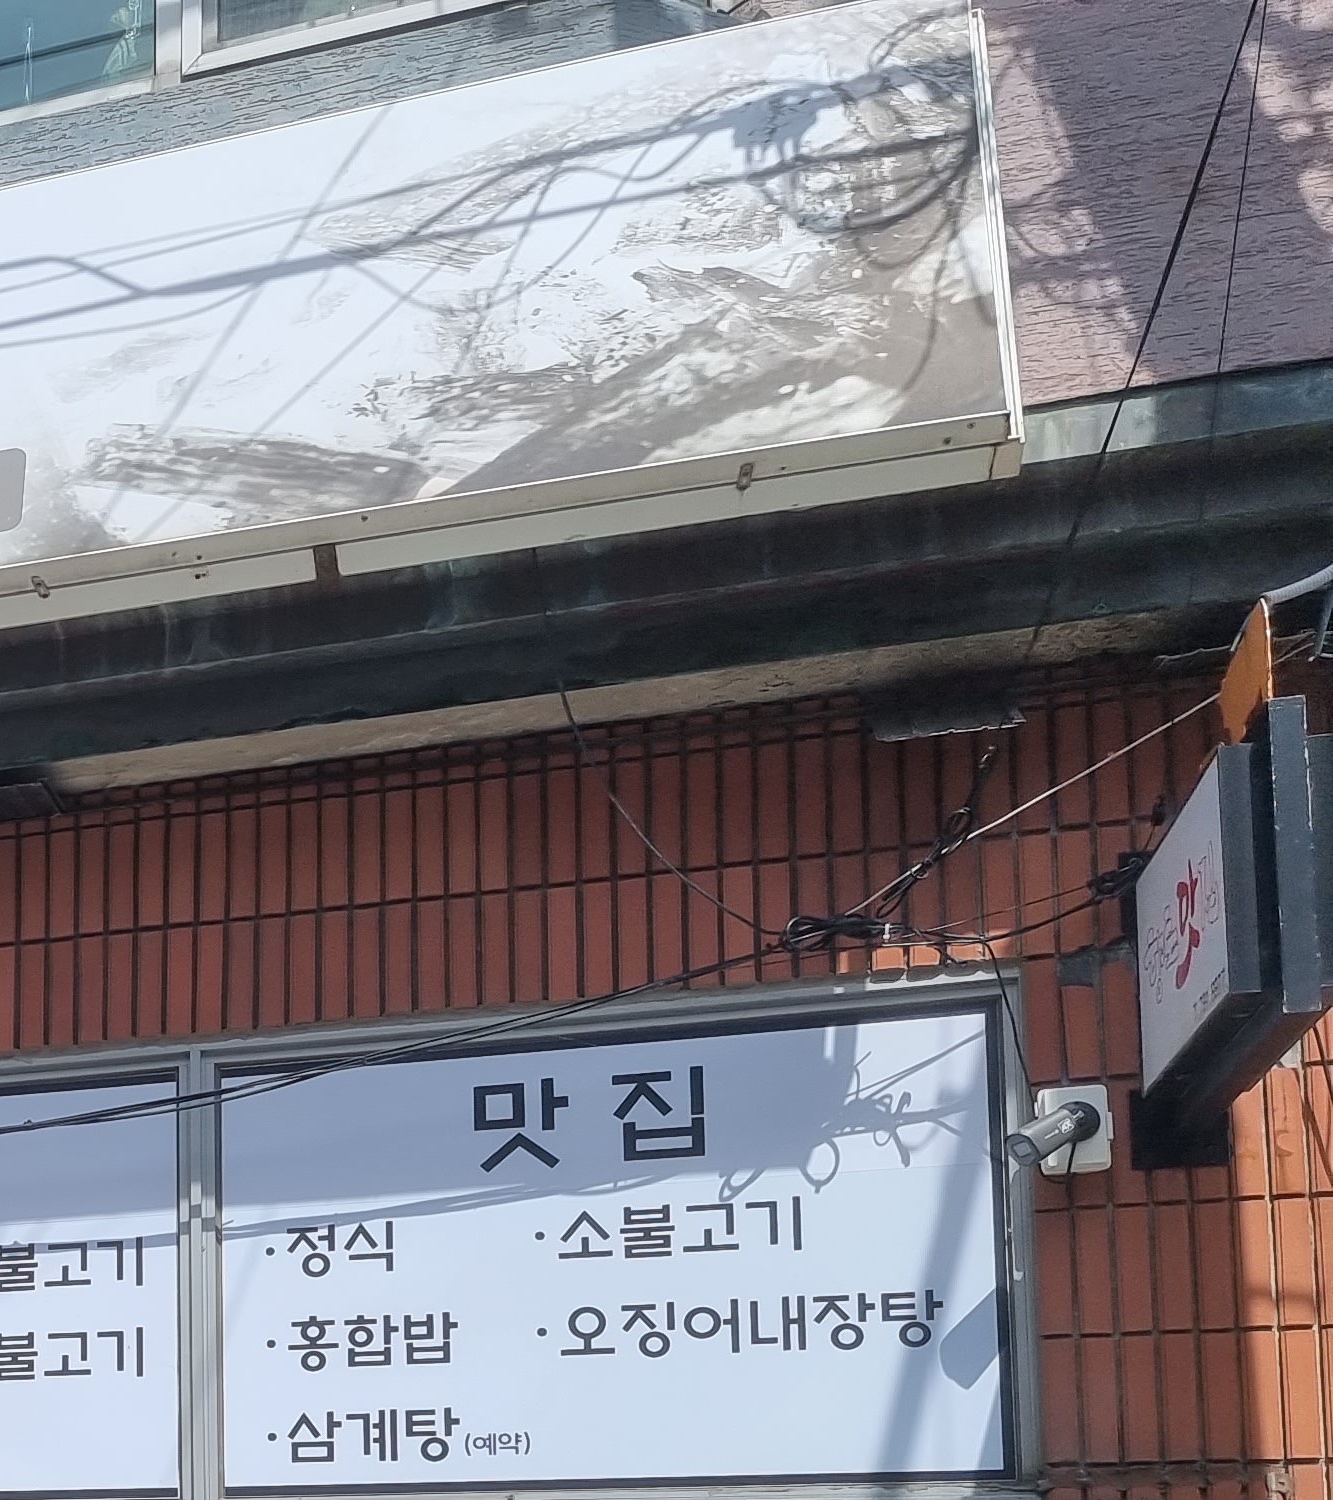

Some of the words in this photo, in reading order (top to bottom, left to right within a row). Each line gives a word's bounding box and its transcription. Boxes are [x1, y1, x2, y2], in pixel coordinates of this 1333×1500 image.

[473, 1066, 706, 1172] 맛집
[286, 1222, 395, 1277] 정식
[557, 1196, 803, 1260] 소불고기
[287, 1312, 459, 1372] 홍합밥
[560, 1290, 943, 1359] 오징어내장탕
[287, 1408, 461, 1463] 삼계탕
[463, 1430, 532, 1458] (예약)
